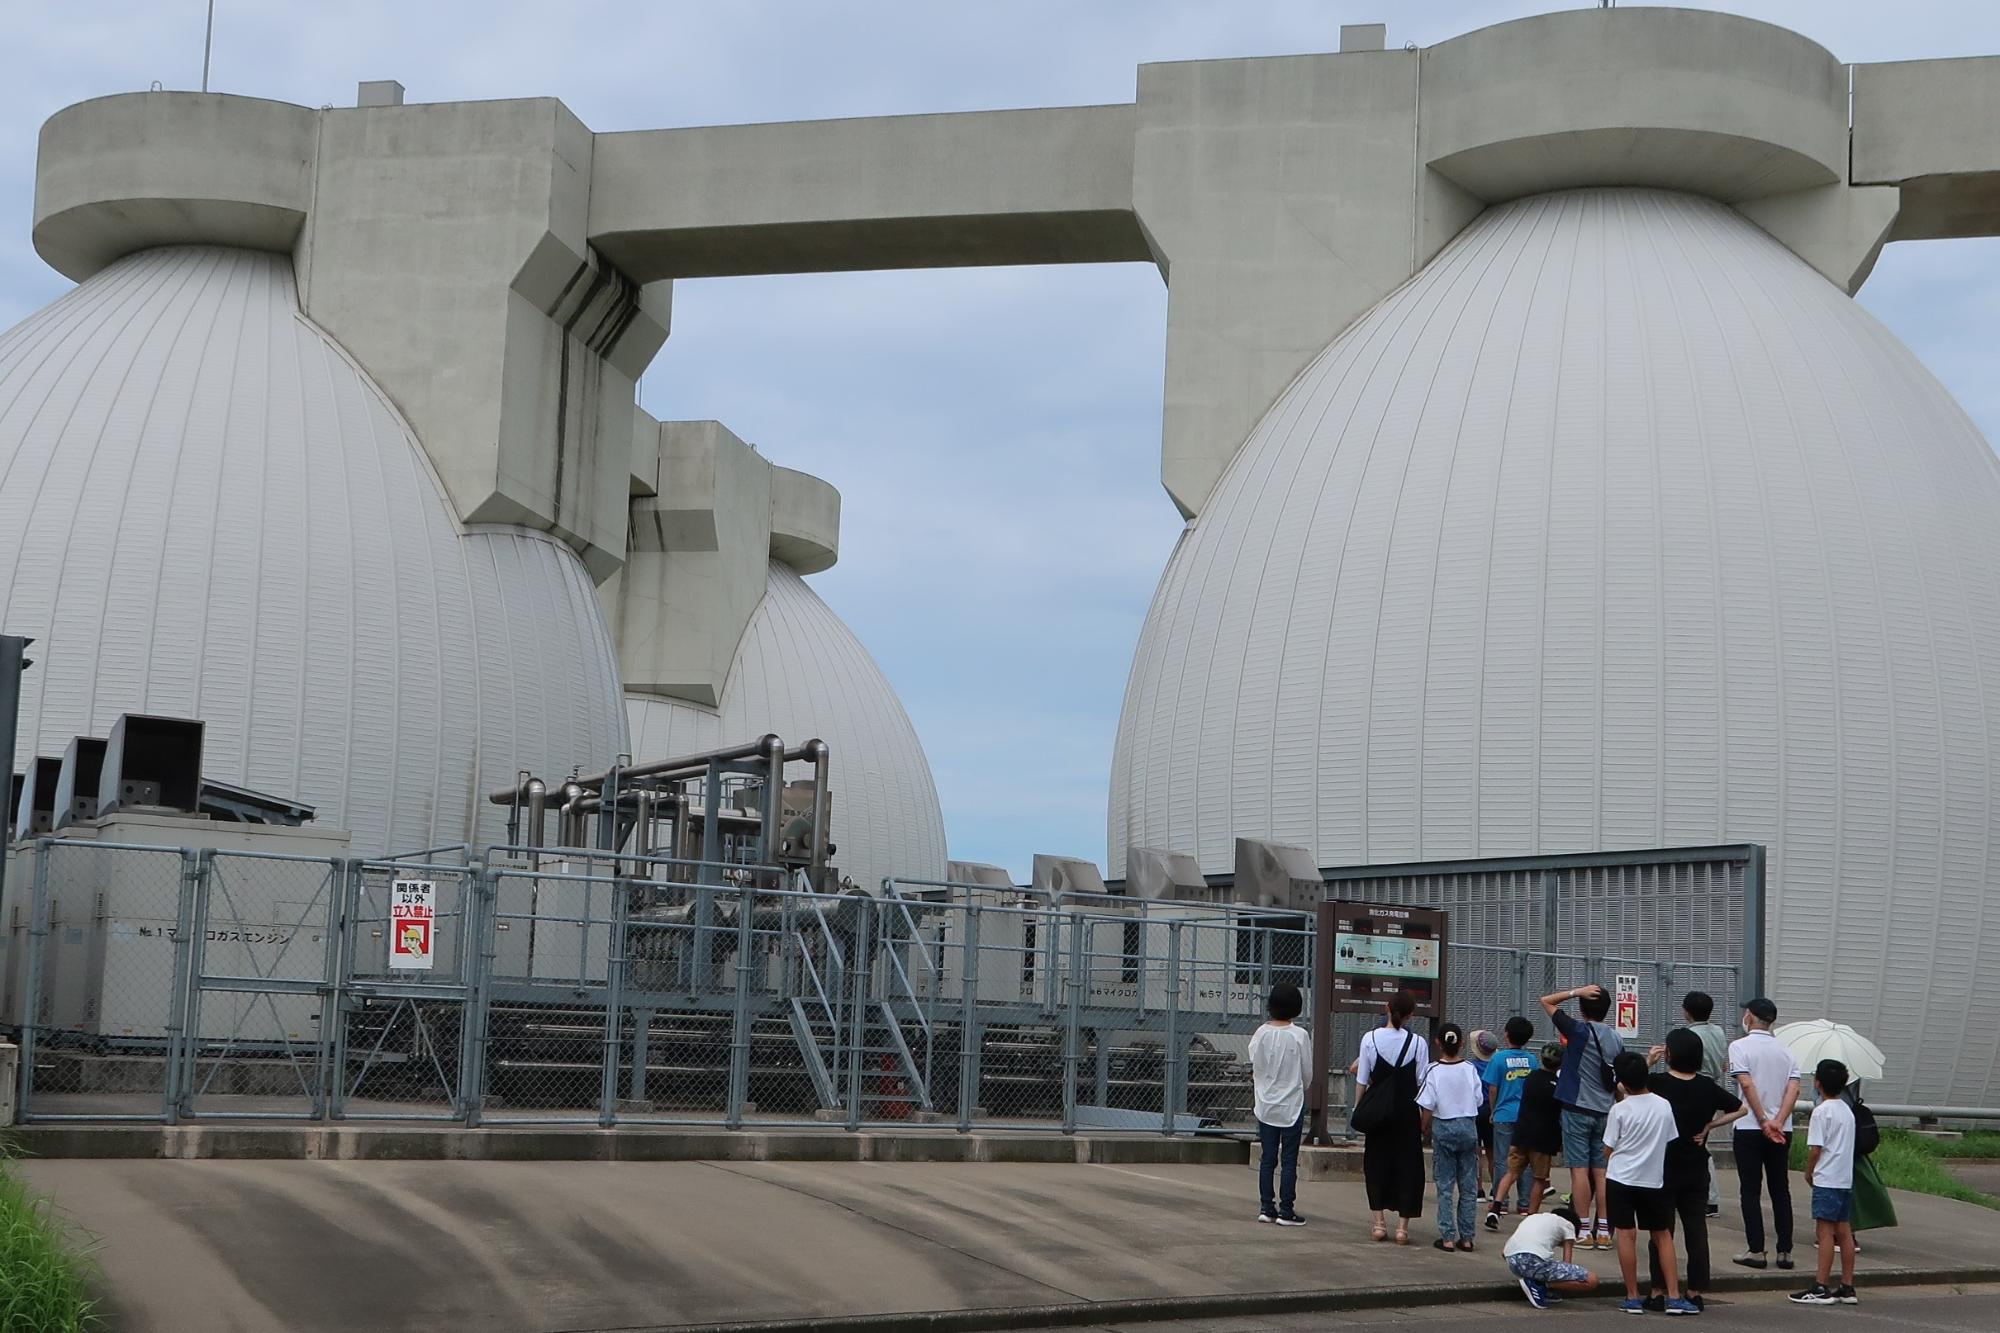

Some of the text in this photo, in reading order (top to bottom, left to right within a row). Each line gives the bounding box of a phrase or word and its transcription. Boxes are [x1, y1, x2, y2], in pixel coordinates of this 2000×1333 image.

[396, 883, 430, 893] 関係者
[402, 894, 425, 904] 以外
[393, 905, 433, 918] 立入禁止
[1617, 992, 1637, 1002] 立入禁止
[1506, 1057, 1530, 1068] MARVEL
